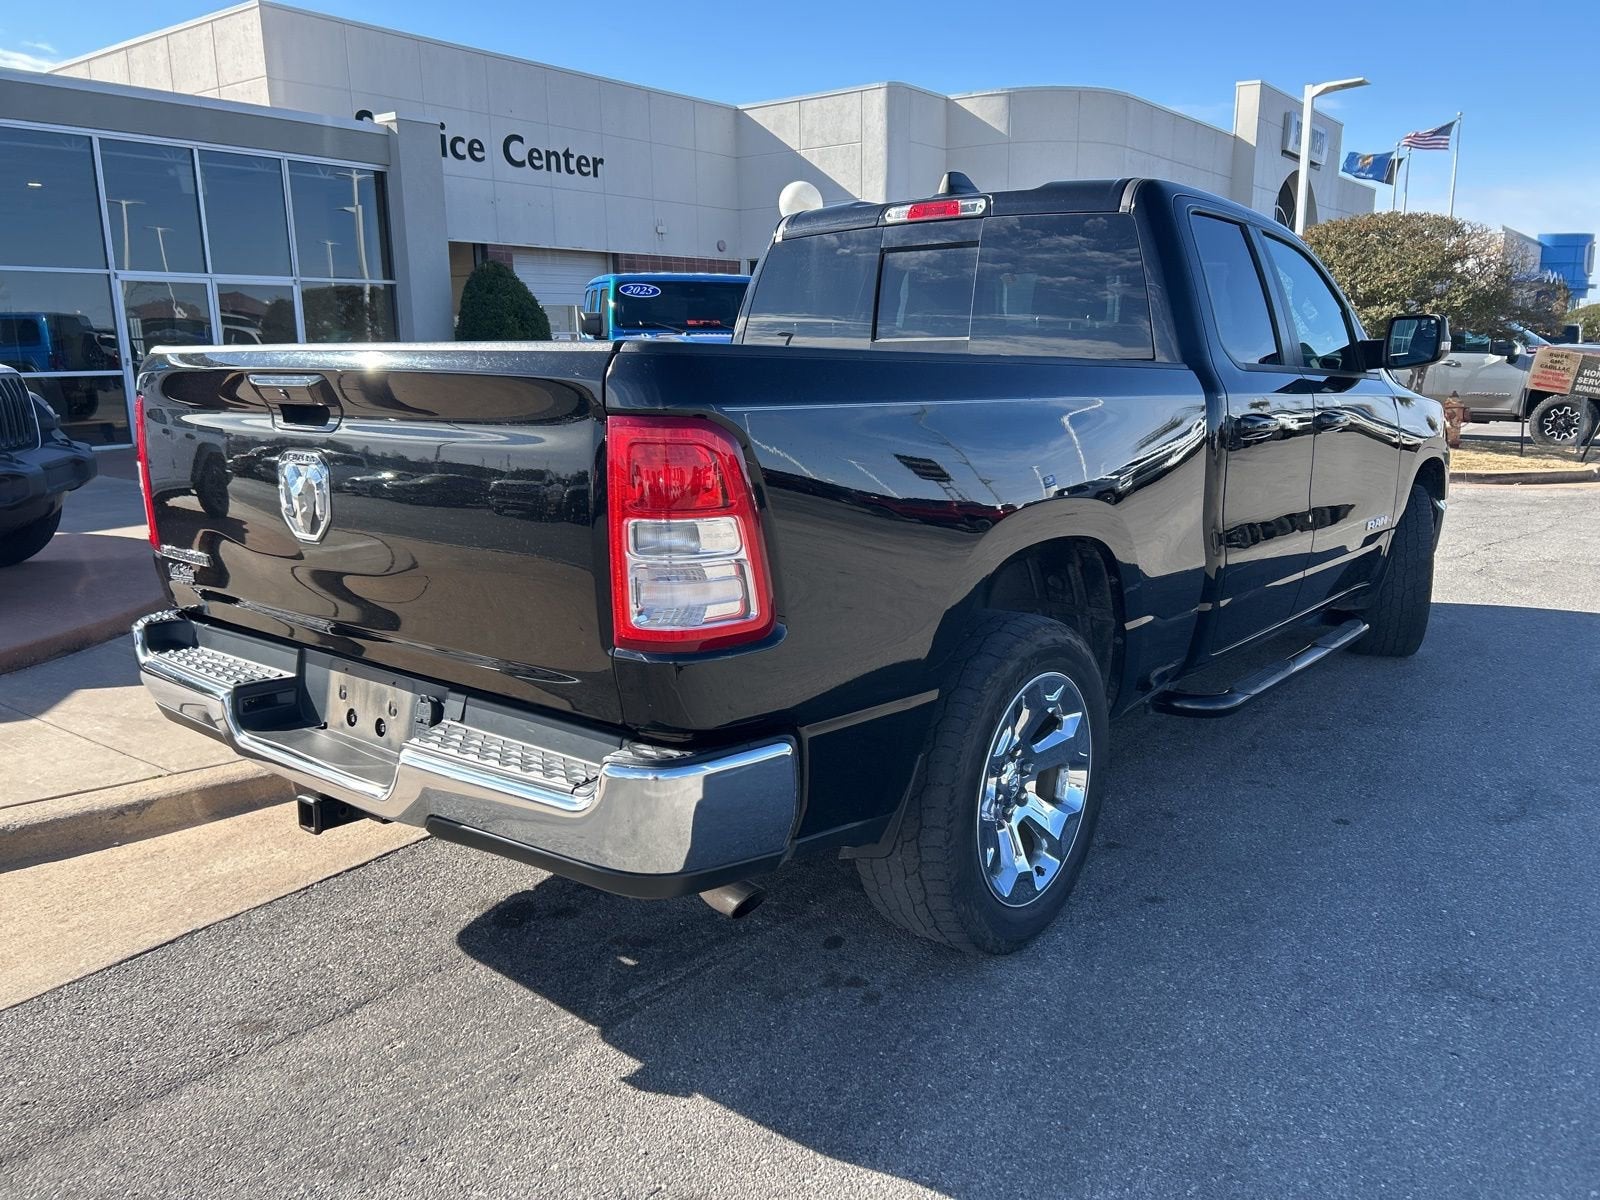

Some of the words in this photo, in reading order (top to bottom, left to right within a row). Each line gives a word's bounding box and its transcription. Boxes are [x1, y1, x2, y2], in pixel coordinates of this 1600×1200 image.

[502, 133, 605, 178] Center
[626, 285, 654, 296] 2025
[1366, 515, 1388, 530] RAM
